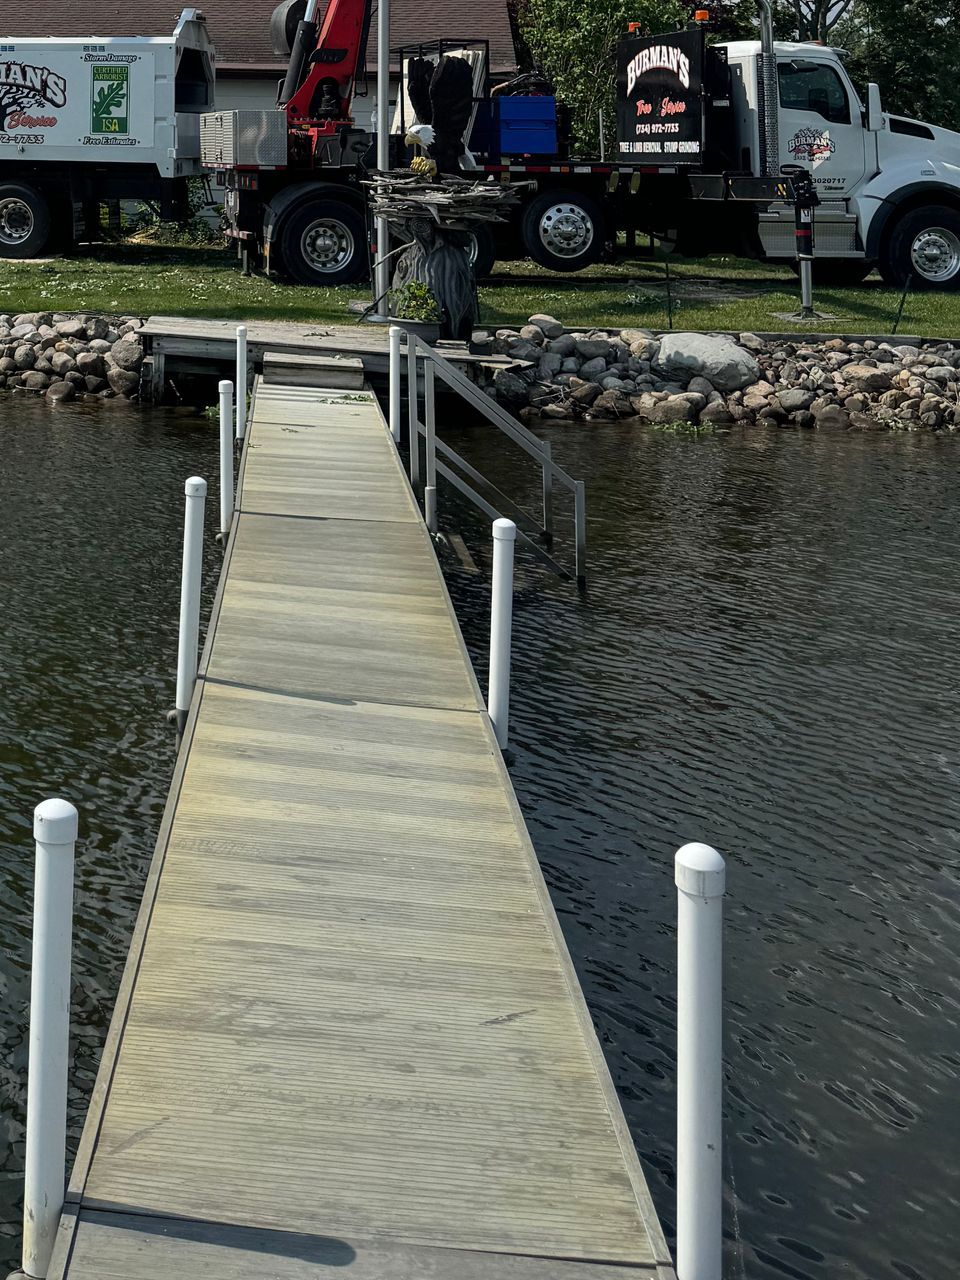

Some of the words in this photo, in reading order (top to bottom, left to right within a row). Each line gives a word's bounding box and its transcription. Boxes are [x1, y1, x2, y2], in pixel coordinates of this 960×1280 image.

[84, 53, 108, 62] Storm
[108, 53, 137, 63] Damage
[627, 46, 689, 97] BURMAN'S
[636, 100, 652, 115] Tree
[7, 111, 57, 129] Service
[102, 119, 119, 131] ISA
[636, 124, 650, 134] (734)
[83, 136, 101, 145] Free
[101, 137, 136, 145] Estimates
[788, 137, 835, 153] BURMAN'S
